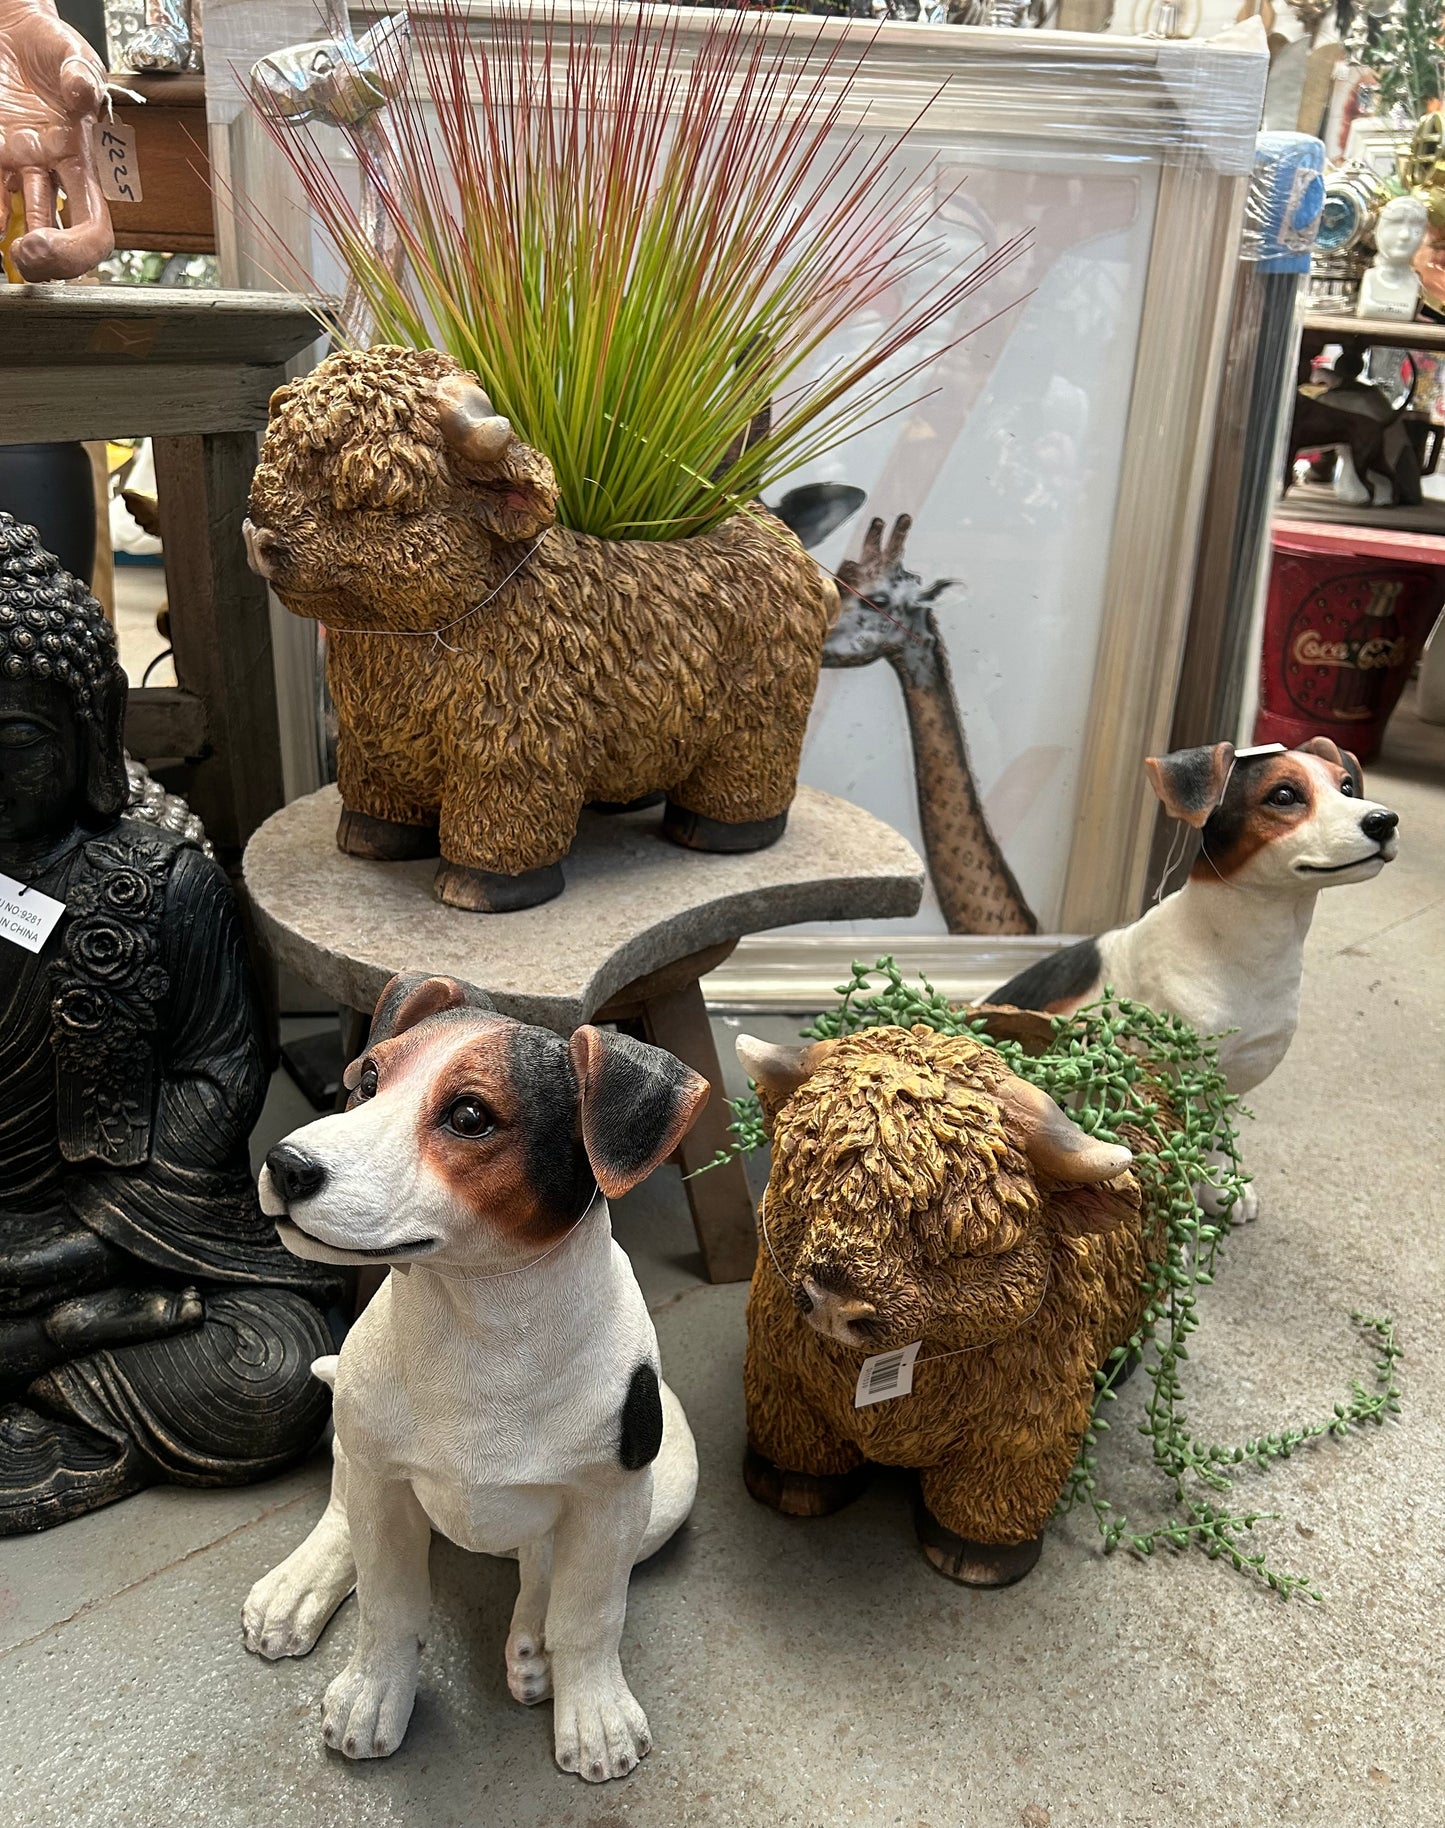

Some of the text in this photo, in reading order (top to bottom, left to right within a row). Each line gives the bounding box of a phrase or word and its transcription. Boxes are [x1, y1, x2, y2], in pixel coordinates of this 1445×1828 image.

[101, 130, 135, 202] £225
[4, 902, 42, 927] NO:9281
[10, 922, 39, 943] CHINA
